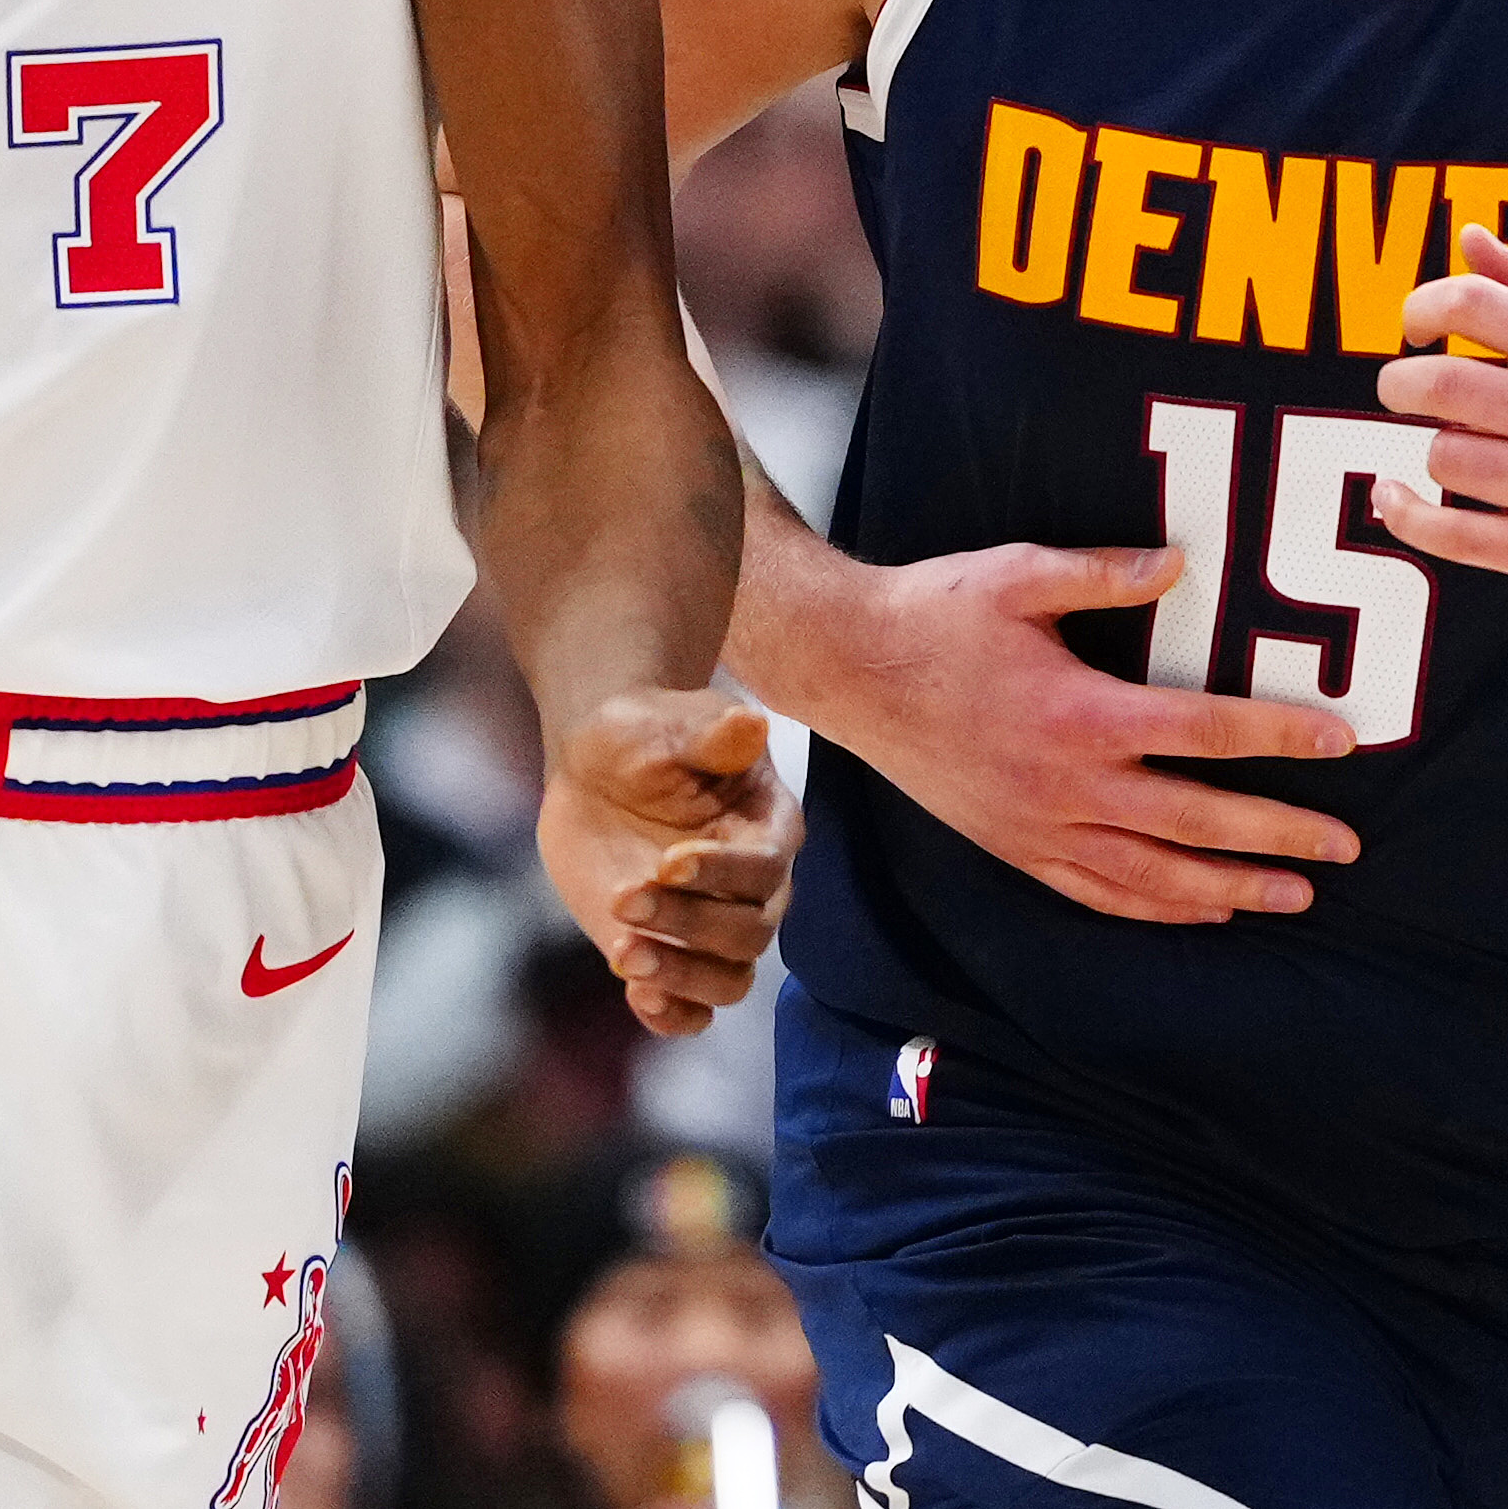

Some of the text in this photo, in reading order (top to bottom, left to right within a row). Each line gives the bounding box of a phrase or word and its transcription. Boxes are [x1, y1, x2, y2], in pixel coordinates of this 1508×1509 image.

[8, 39, 224, 309] 7
[1144, 393, 1443, 751] 15
[890, 1097, 911, 1119] NBA
